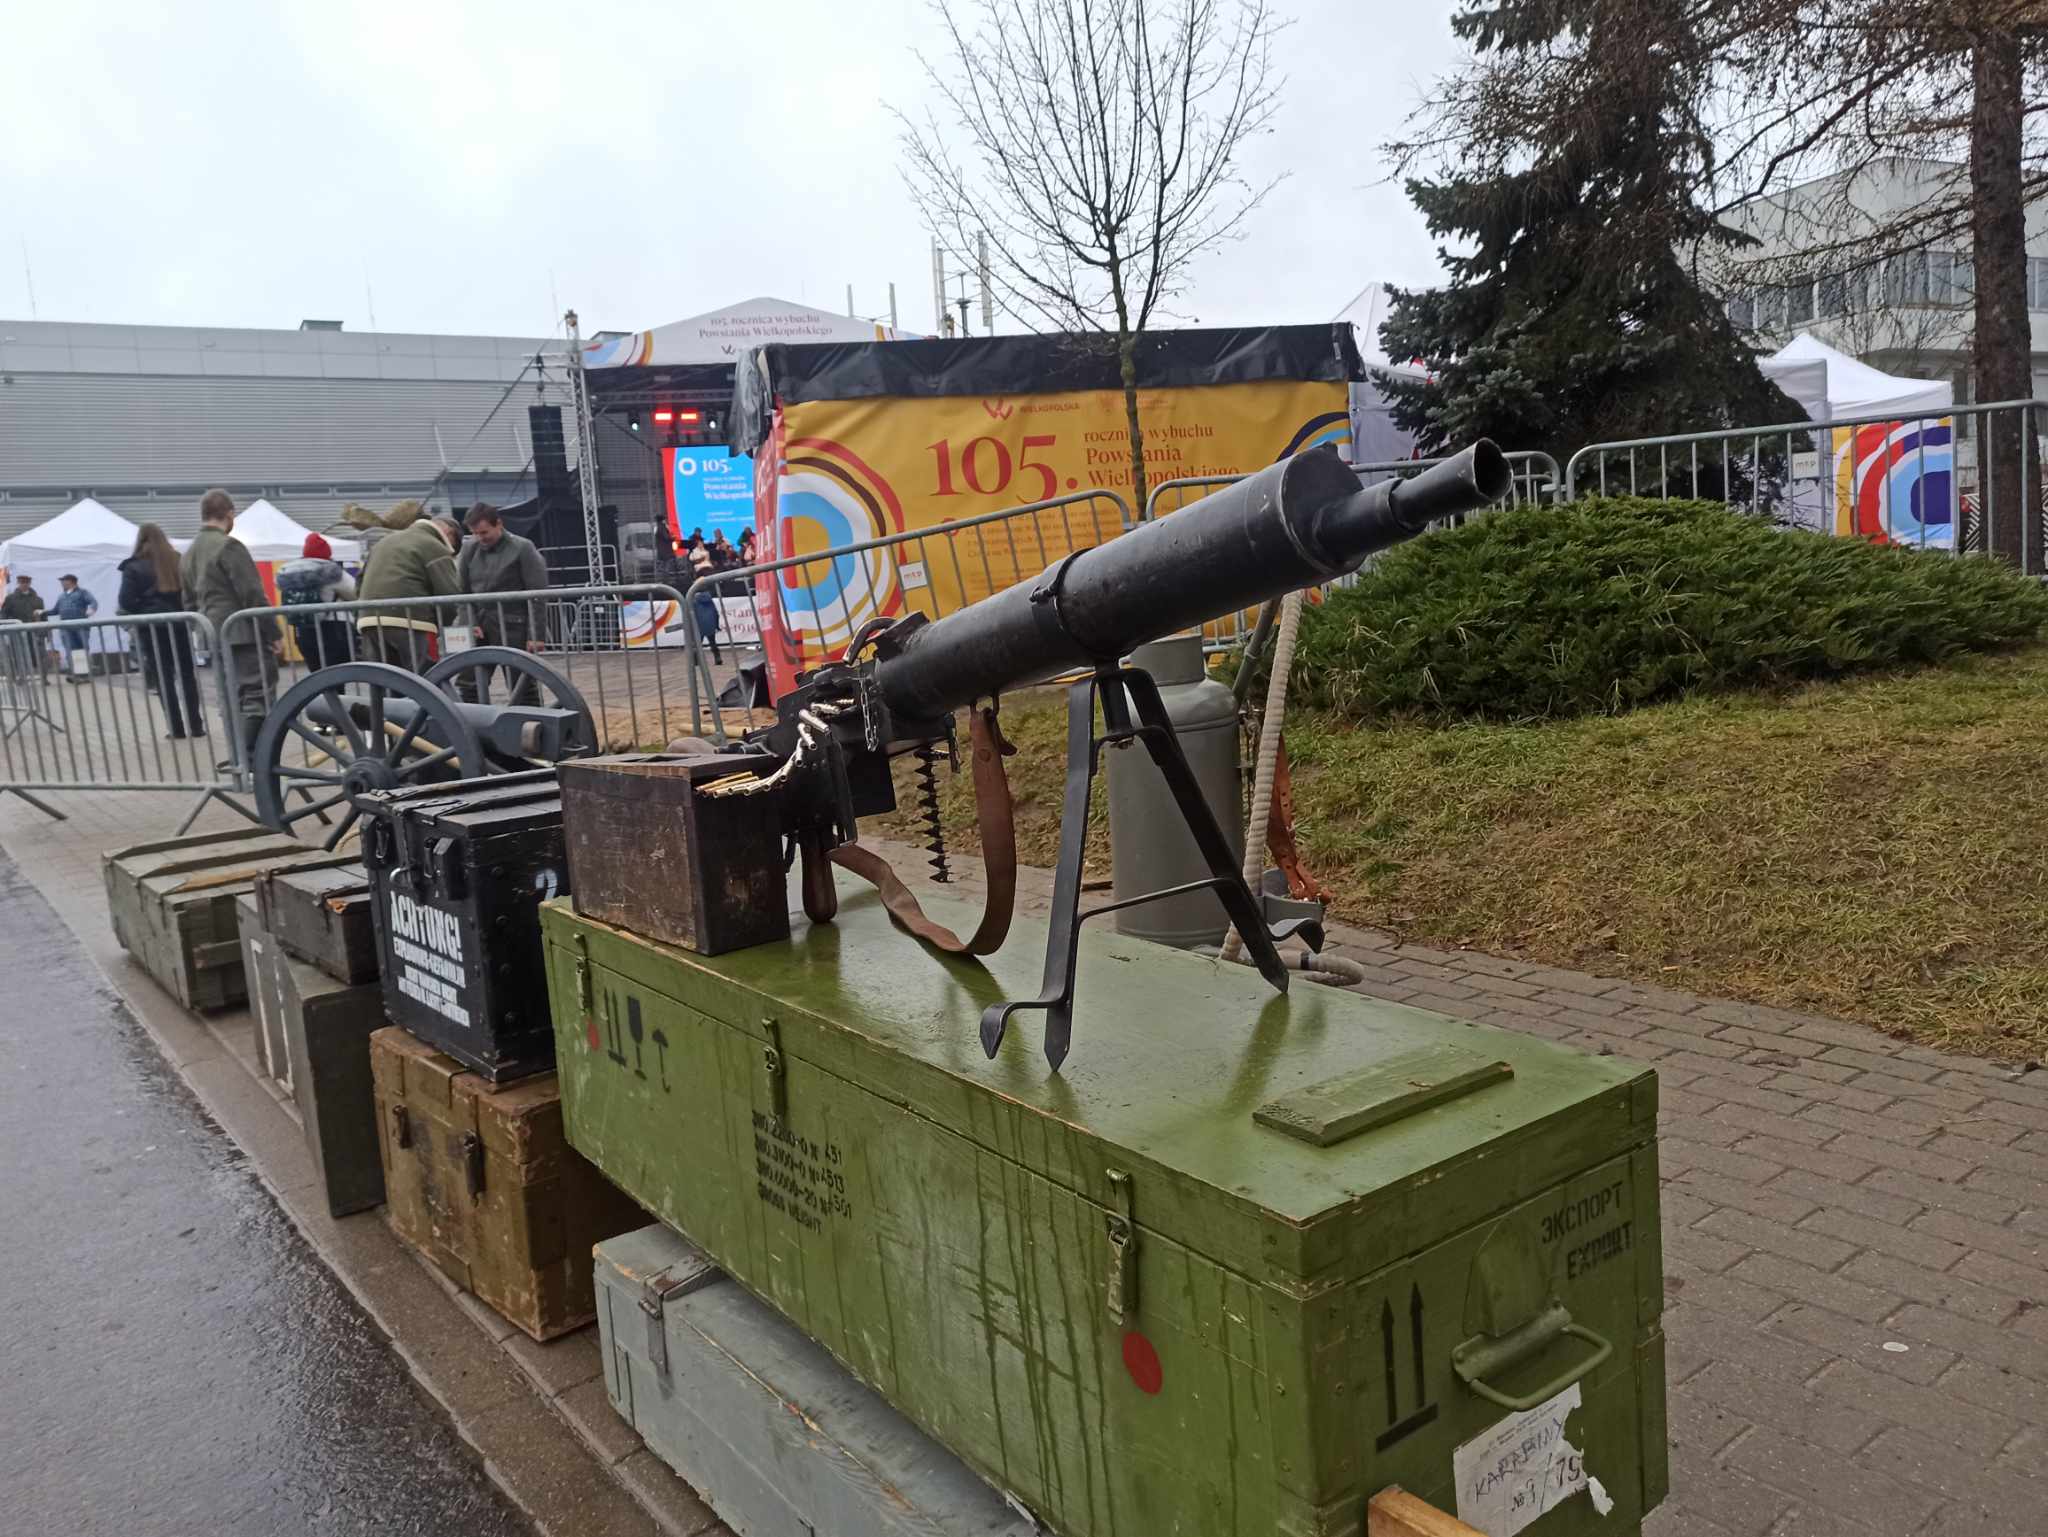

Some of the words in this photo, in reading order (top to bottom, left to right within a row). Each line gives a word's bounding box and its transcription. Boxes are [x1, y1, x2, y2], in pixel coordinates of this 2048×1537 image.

[699, 325, 750, 338] Powstania
[752, 325, 833, 337] Wielkopolskiego
[1150, 424, 1214, 442] wybuchu
[1086, 444, 1183, 465] Powsania
[702, 459, 732, 474] 105.
[925, 433, 1079, 503] 105.
[1088, 464, 1240, 488] Wielopolskiego
[389, 889, 464, 963] ACHTUNG!
[1541, 1180, 1624, 1245] ЭКСПОРТ
